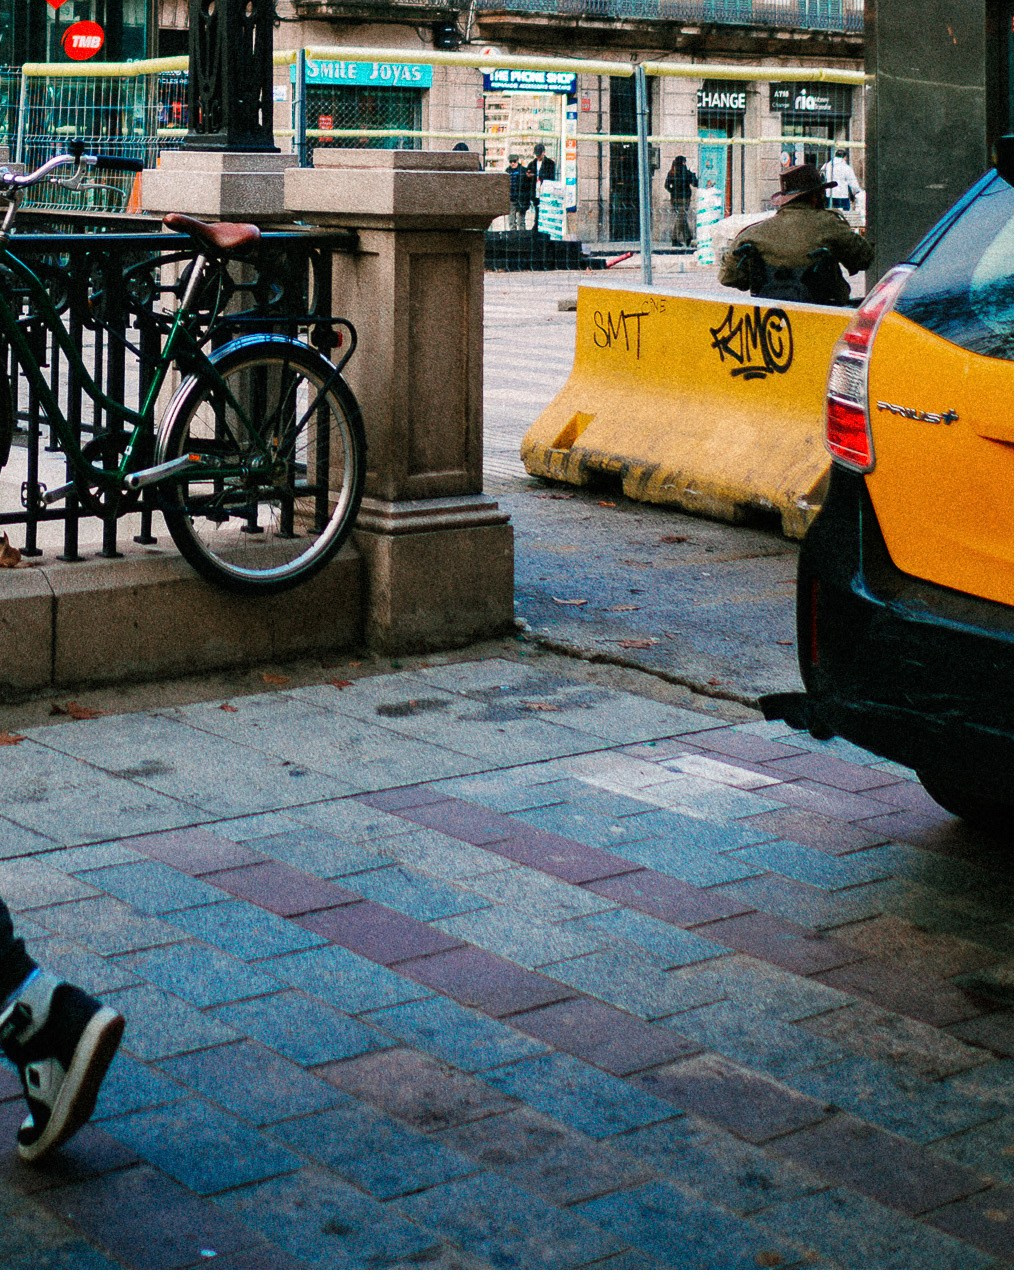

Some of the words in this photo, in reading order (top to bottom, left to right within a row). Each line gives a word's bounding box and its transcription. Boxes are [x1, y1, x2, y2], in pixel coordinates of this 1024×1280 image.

[72, 34, 102, 49] TMB
[369, 62, 423, 86] JOYAS
[510, 70, 547, 84] PHONE
[546, 71, 576, 85] SHOP
[696, 91, 746, 110] CHANGE
[773, 90, 790, 98] ATM
[794, 88, 816, 111] ria
[593, 310, 650, 360] SMT
